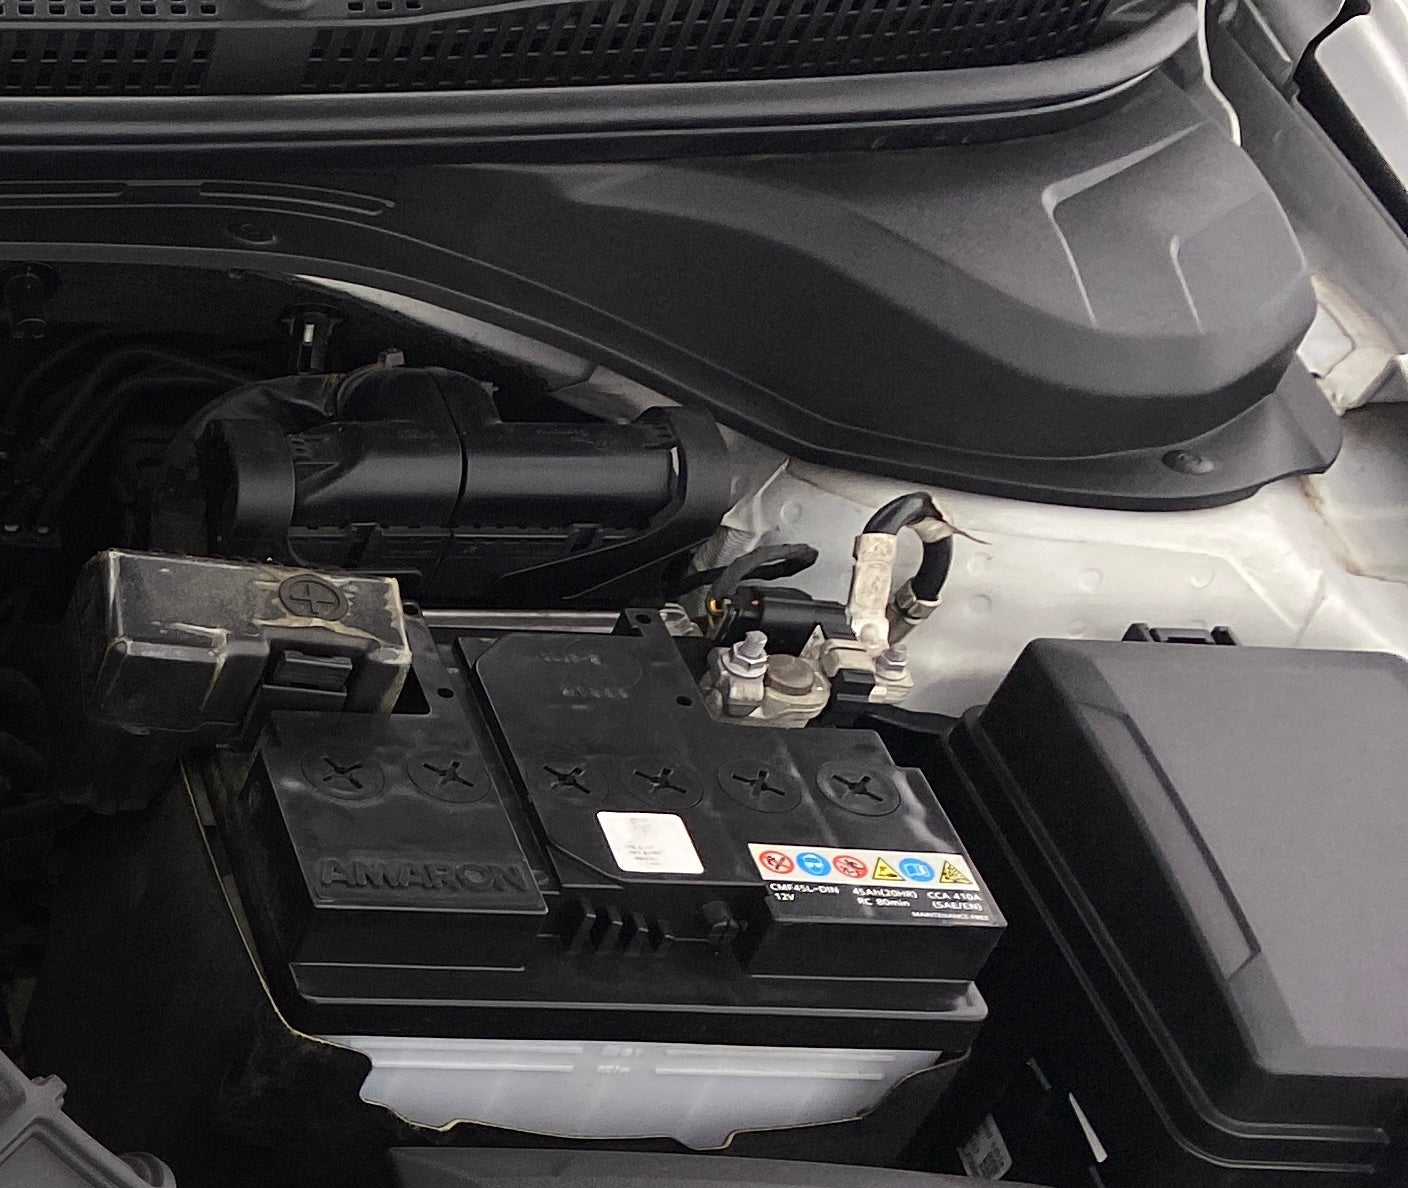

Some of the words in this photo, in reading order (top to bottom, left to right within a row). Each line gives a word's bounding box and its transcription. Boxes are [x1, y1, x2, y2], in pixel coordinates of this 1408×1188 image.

[319, 857, 531, 891] AMARON
[774, 892, 795, 901] 12V
[927, 891, 950, 900] CCA
